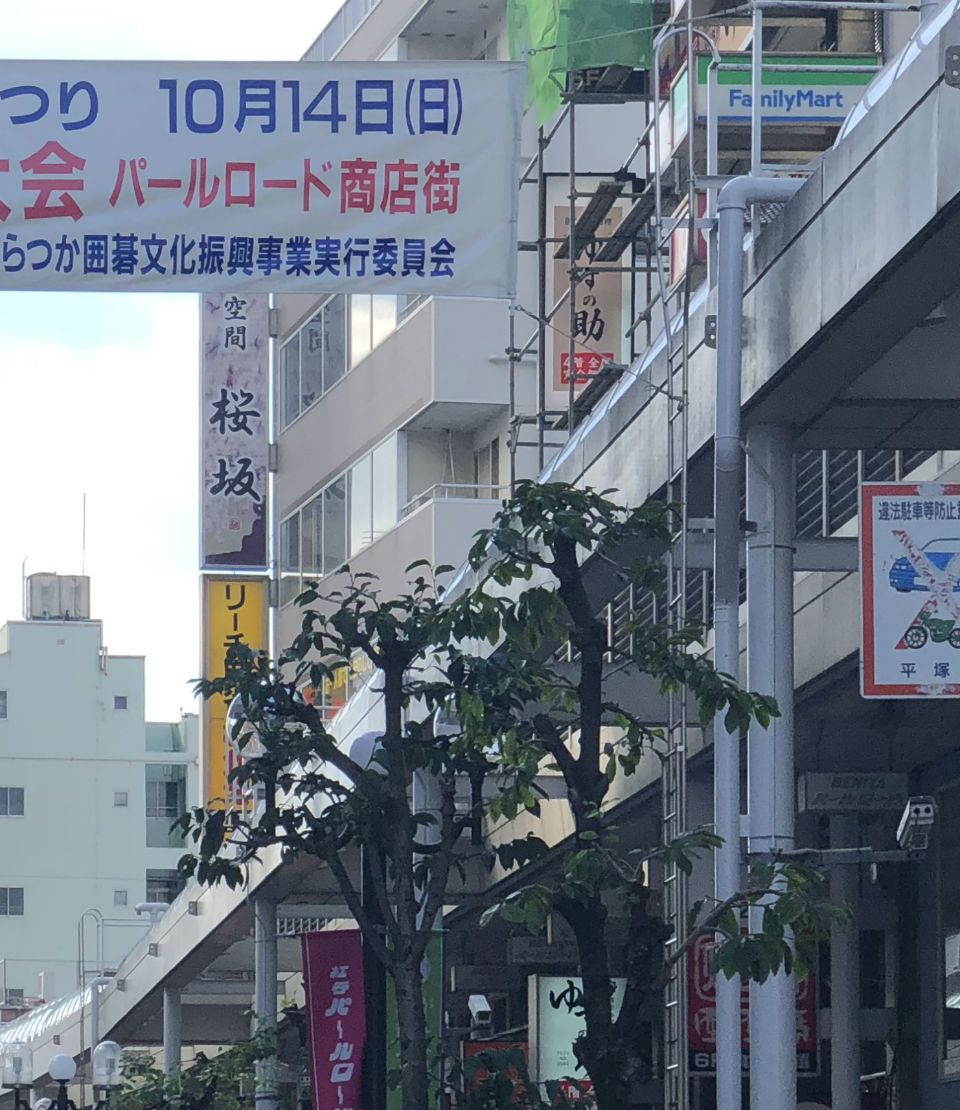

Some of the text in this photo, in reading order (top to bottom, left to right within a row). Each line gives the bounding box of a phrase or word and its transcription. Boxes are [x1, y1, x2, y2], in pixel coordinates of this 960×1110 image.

[158, 77, 463, 136] 10月14日(日)
[728, 88, 844, 113] FamilyMart
[108, 156, 461, 216] パールロード商店街
[209, 388, 262, 501] 桜坂
